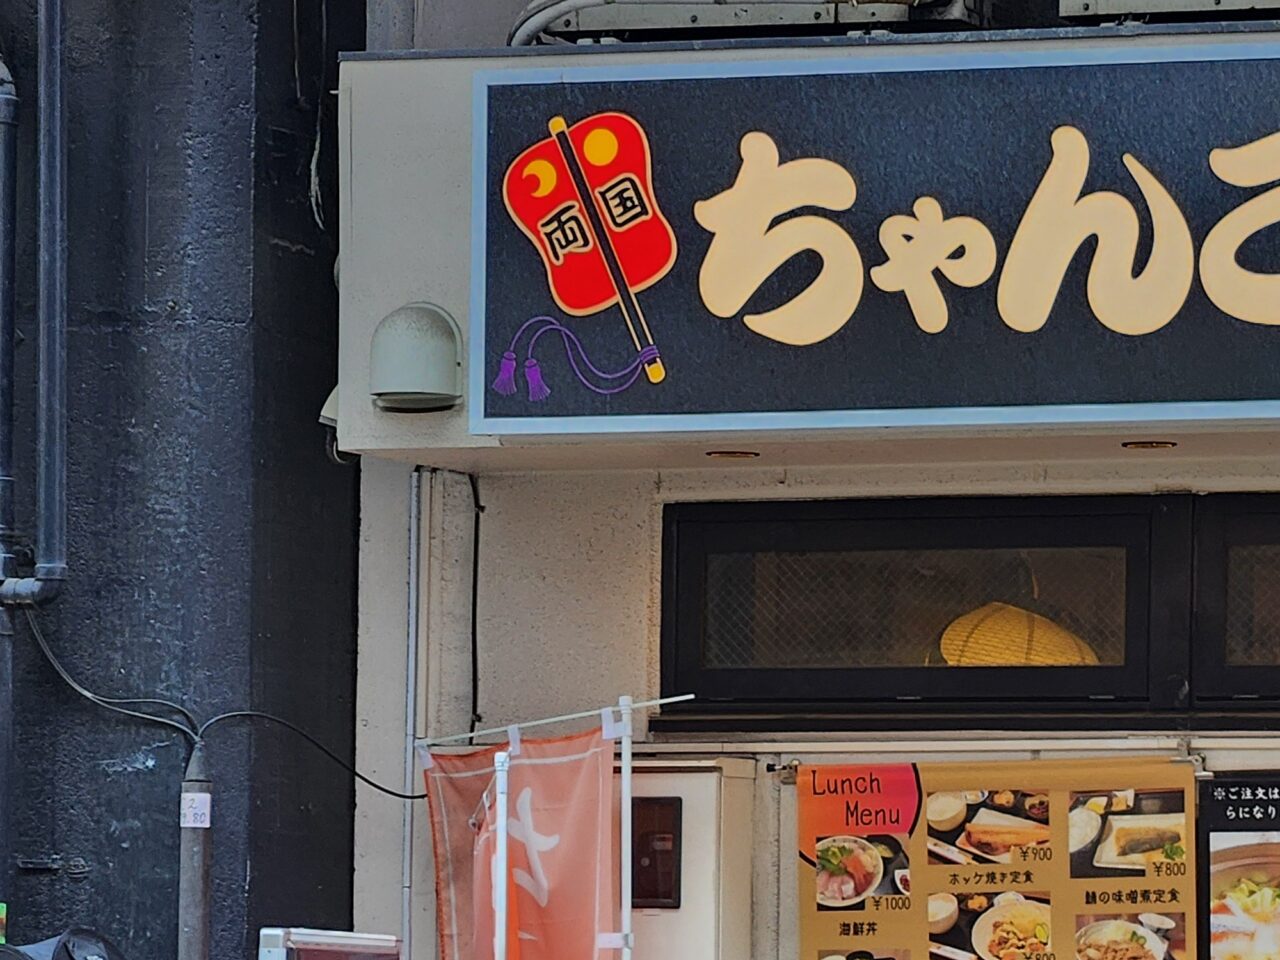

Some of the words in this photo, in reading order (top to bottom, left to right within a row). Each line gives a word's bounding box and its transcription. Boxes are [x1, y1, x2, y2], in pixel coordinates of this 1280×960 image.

[540, 176, 650, 262] 両国
[811, 770, 881, 796] Lunch
[845, 801, 901, 827] Menu
[1019, 847, 1053, 861] ¥900
[1153, 863, 1187, 876] ¥800
[949, 871, 1034, 885] ホッケ焼き定食
[872, 897, 911, 911] ¥1000
[839, 922, 877, 936] 海鮮丼
